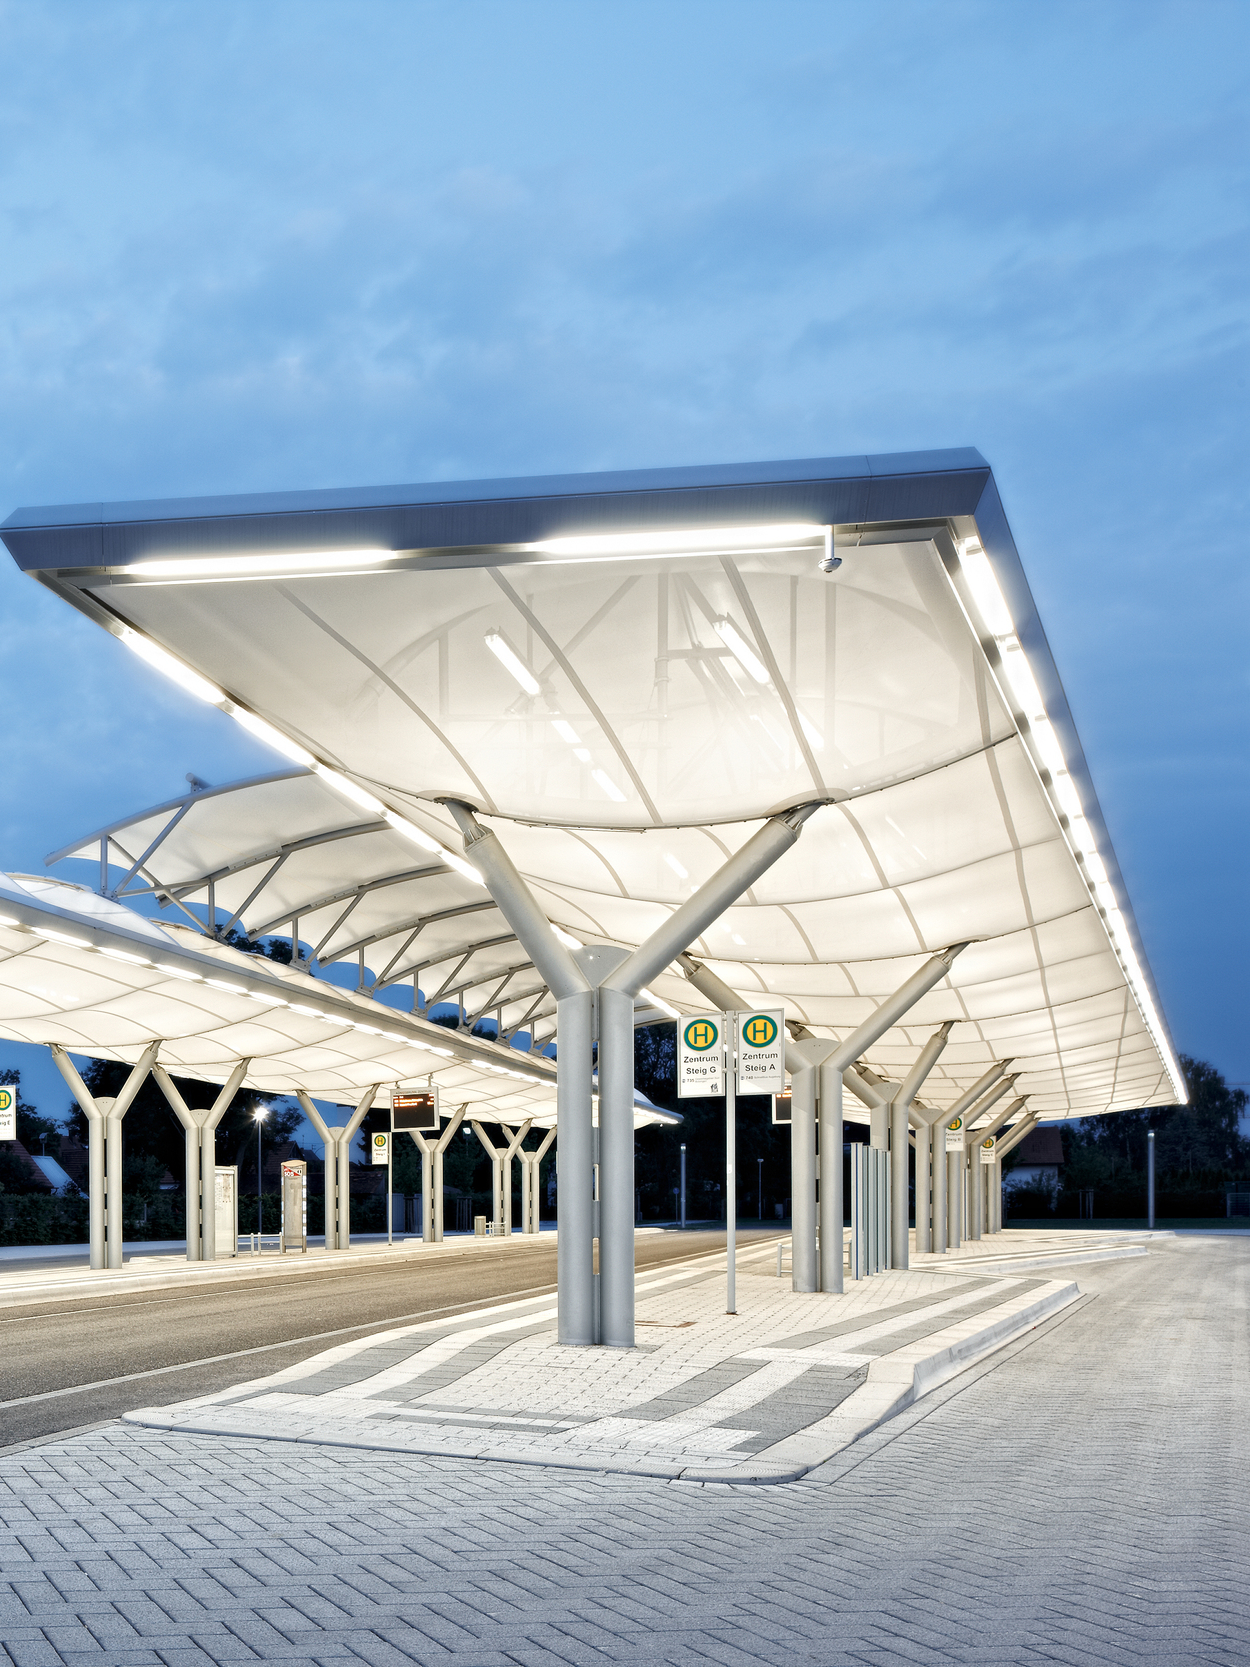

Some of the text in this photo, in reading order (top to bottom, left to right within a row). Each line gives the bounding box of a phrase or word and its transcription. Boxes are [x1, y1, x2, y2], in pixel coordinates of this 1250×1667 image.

[694, 1026, 708, 1044] H
[753, 1022, 767, 1041] H
[686, 1067, 707, 1075] Steig
[745, 1064, 767, 1073] Steig
[0, 1095, 6, 1106] H
